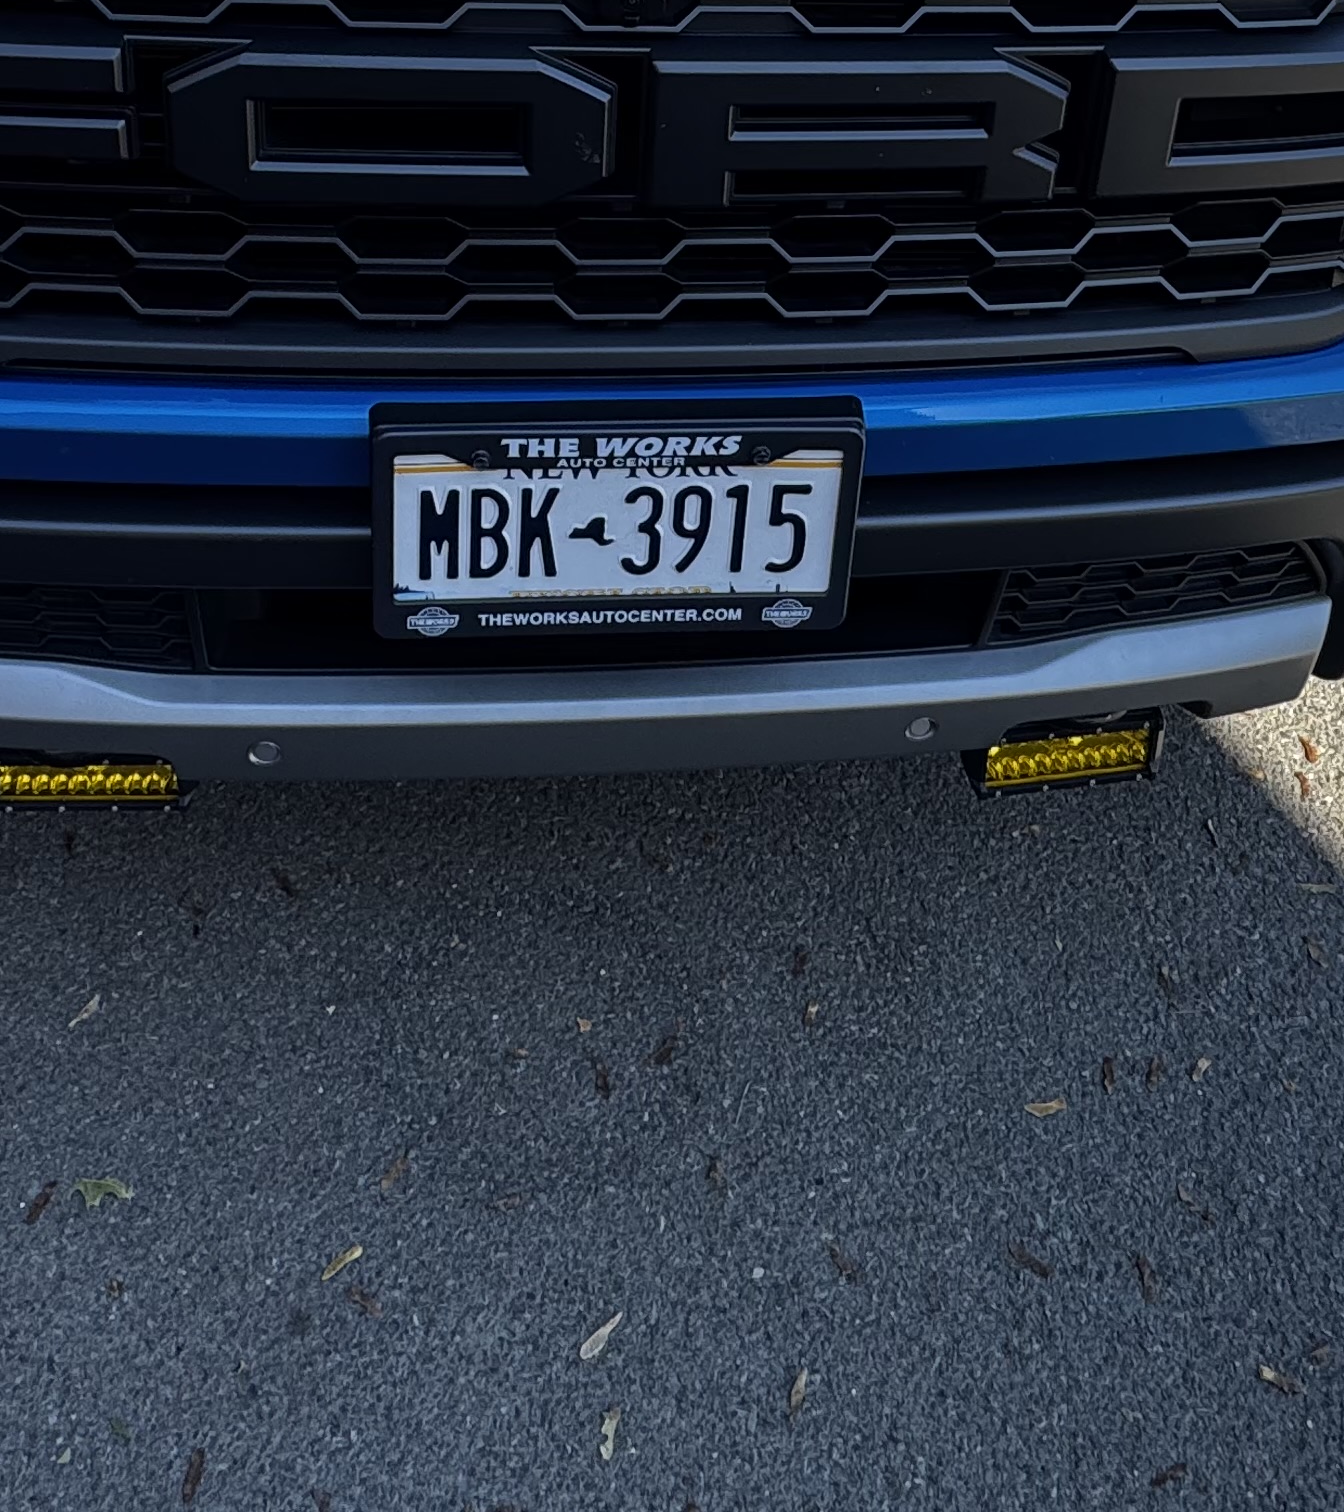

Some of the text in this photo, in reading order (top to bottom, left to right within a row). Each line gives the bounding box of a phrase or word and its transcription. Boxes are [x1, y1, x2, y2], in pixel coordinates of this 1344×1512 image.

[500, 434, 744, 459] THE WORKS
[556, 455, 686, 469] AUTO CENTER
[418, 482, 814, 581] MBK 3915
[477, 607, 743, 627] THEWORKSAUTOCENTER.COM
